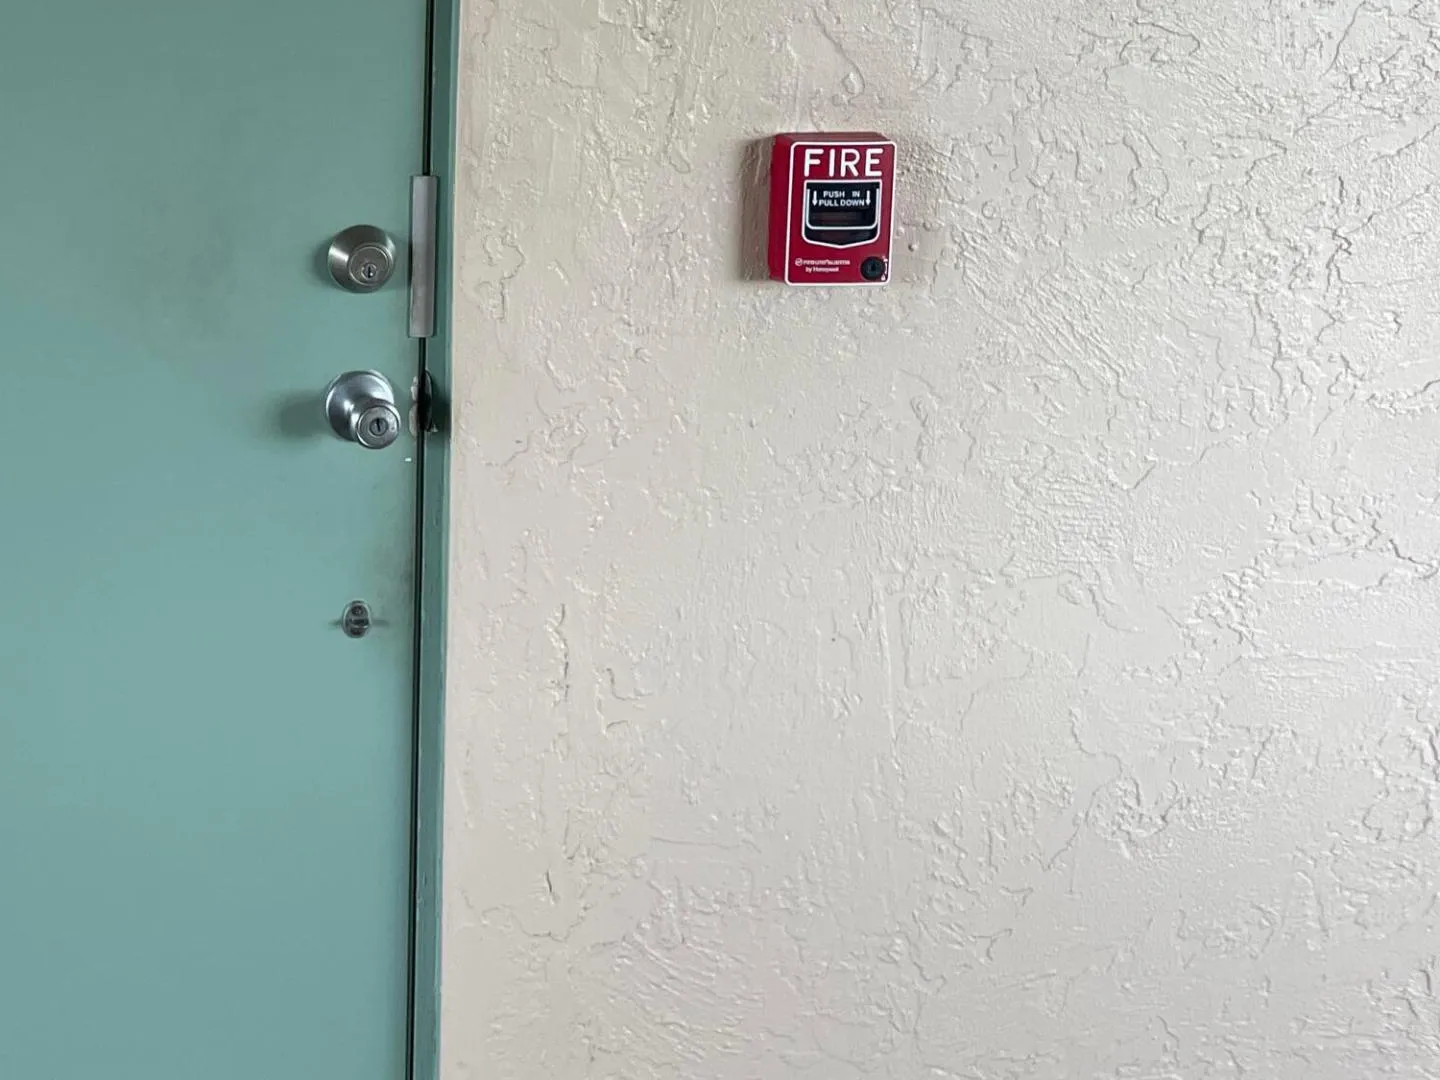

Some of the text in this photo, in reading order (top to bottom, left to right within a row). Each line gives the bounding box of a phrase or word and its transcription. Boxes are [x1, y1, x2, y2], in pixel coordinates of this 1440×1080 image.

[803, 148, 884, 177] FIRE
[823, 190, 860, 198] PUSH IN
[818, 199, 865, 207] PULL DOWN
